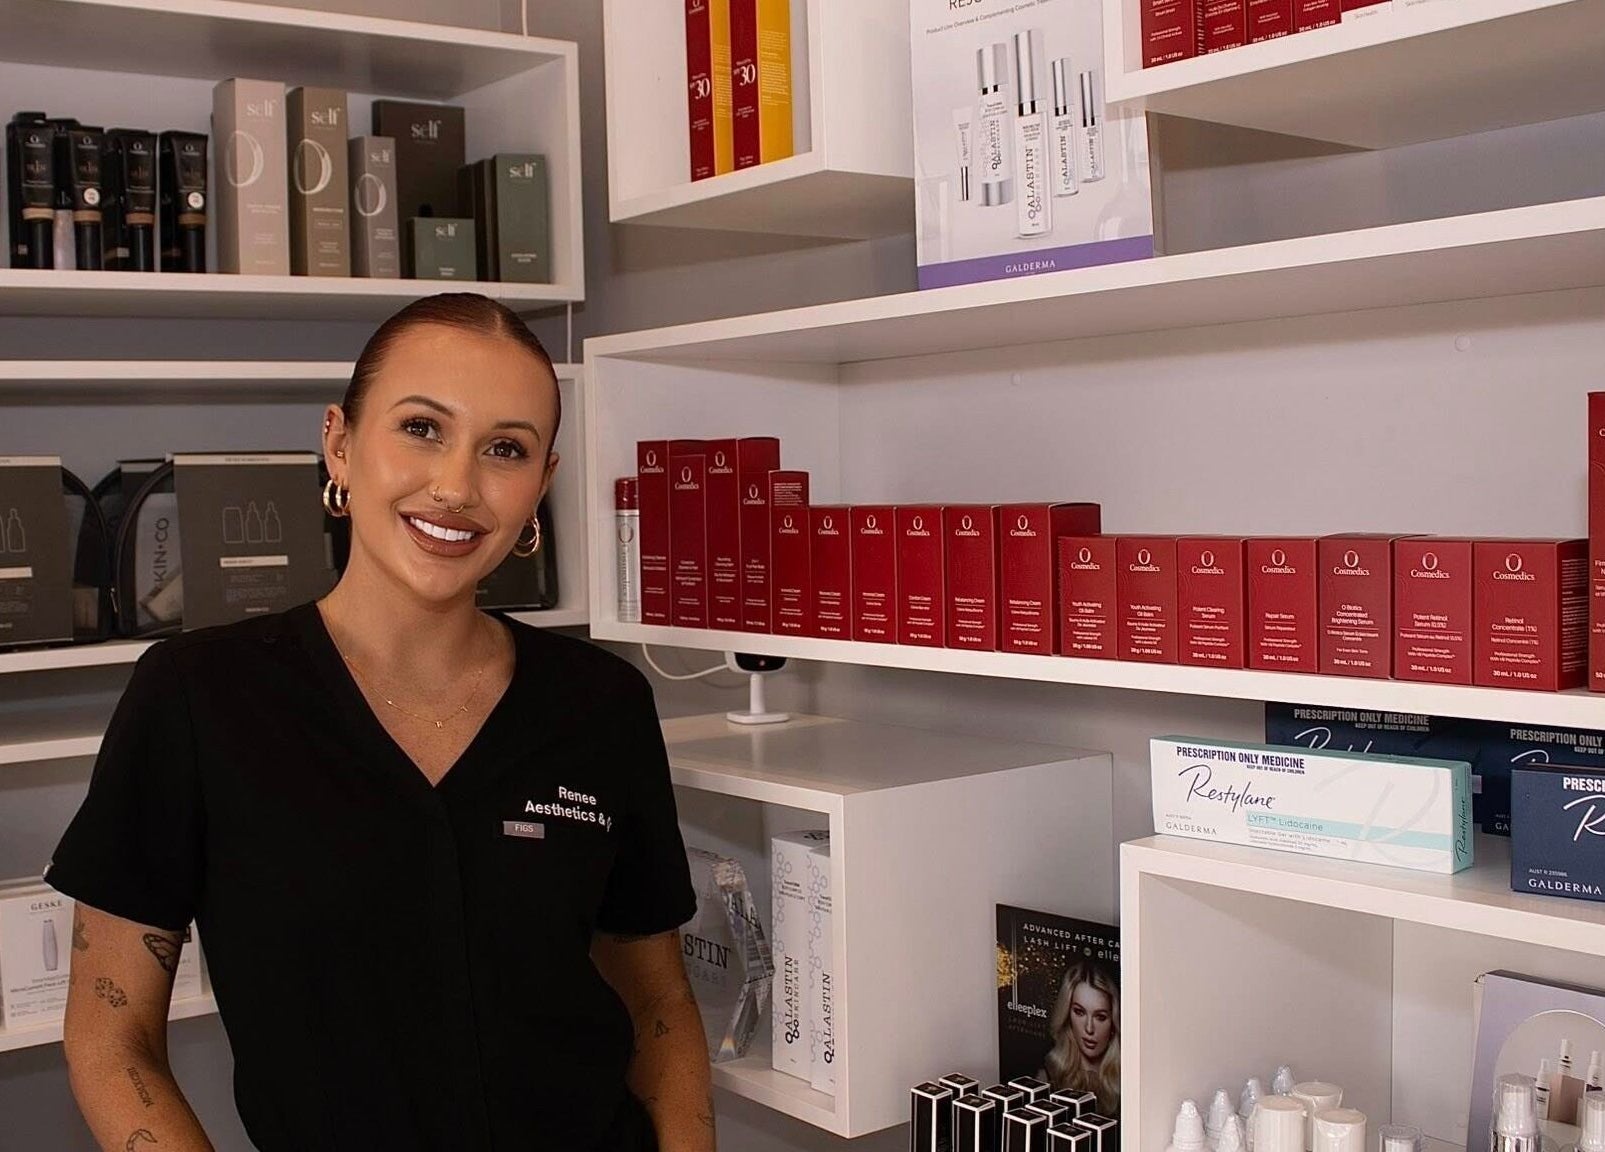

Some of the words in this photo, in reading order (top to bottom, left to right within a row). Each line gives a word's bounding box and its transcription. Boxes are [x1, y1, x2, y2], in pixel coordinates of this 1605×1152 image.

[740, 64, 756, 86] 30
[695, 78, 710, 100] 30
[311, 108, 341, 126] self
[410, 120, 442, 140] self
[509, 162, 536, 178] self
[1026, 148, 1036, 208] ALASTIN
[435, 223, 458, 237] self
[1005, 260, 1056, 274] GALDERMA
[818, 528, 840, 536] Cosmedics
[860, 527, 884, 535] Cosmedics
[906, 529, 930, 537] Cosmedics
[955, 528, 980, 537] Cosmedics
[1010, 529, 1037, 537] Cosmedics
[1071, 562, 1100, 570] Cosmedics
[1129, 564, 1160, 572] Cosmedics
[1192, 566, 1224, 575] Cosmedics
[1262, 565, 1296, 574] Cosmedics
[1333, 566, 1370, 576] Cosmedics
[1410, 568, 1450, 579] Cosmedics
[1493, 570, 1535, 581] Cosmedics
[1492, 624, 1524, 632] Concentrate
[1294, 708, 1358, 722] PRESCRIPTION
[1360, 712, 1381, 723] ONLY
[1384, 714, 1430, 726] MEDICINE
[1510, 728, 1577, 744] PRESCRIPTION
[1580, 735, 1602, 747] ONLY
[1176, 746, 1236, 762] PRESCRIPTION
[1239, 752, 1260, 764] ONLY
[1262, 755, 1306, 769] MEDICINE
[558, 786, 597, 806] Renee
[525, 800, 596, 823] Aesthetics
[598, 812, 606, 826] &
[514, 824, 534, 832] FIGS
[1166, 822, 1217, 836] GALDERMA
[1279, 818, 1324, 832] Lidocaine
[1456, 796, 1468, 862] Restylane
[1528, 878, 1602, 895] GALDERMA
[30, 900, 62, 910] GESKE
[1024, 923, 1071, 939] ADVANCED
[1075, 934, 1104, 946] AFTER
[1024, 936, 1049, 947] LASH
[1054, 944, 1078, 952] LIFT
[1098, 950, 1120, 962] elle
[784, 956, 794, 1032] ALASTIN
[822, 972, 832, 1051] ALASTIN
[1008, 1002, 1047, 1018] elleeplex
